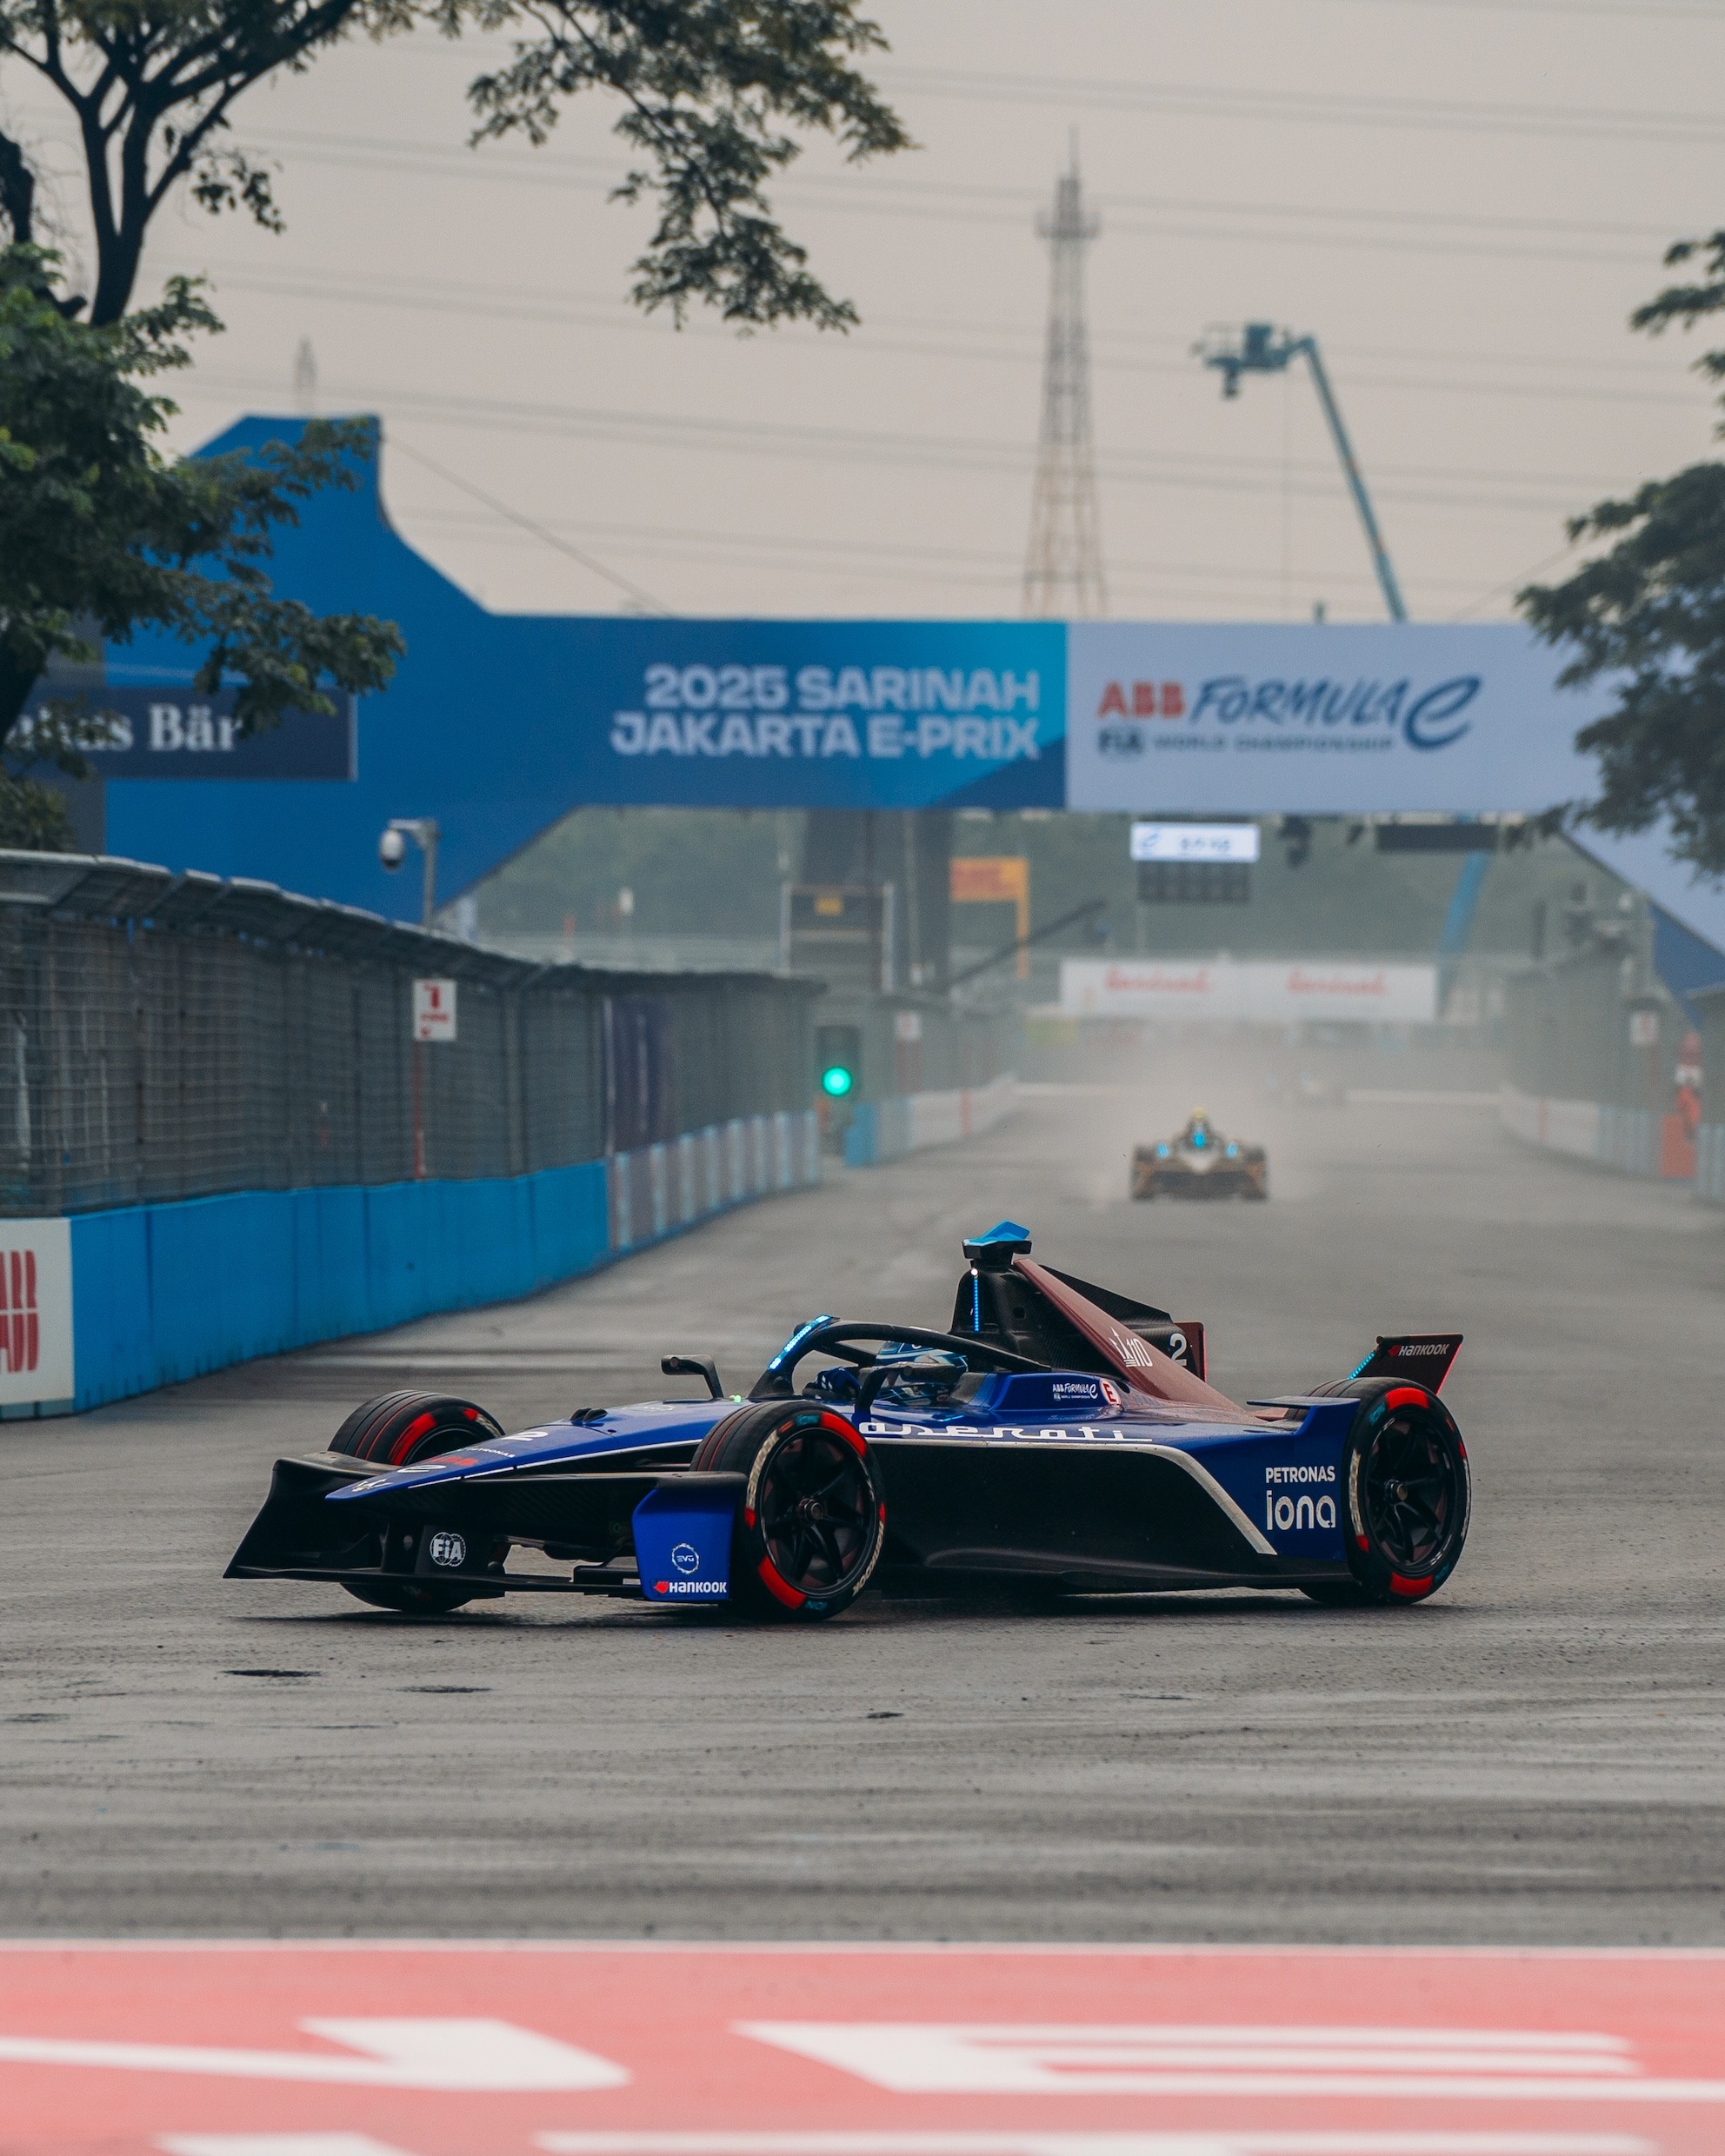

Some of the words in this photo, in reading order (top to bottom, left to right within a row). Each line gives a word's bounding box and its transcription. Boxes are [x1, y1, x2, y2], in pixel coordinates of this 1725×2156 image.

[644, 664, 789, 709] 2025
[796, 666, 1040, 712] SARINAH
[1097, 682, 1185, 719] ABB
[1189, 675, 1409, 725] FORMULA
[149, 702, 244, 751] Bär
[610, 711, 861, 756] JAKARTA
[868, 715, 1041, 760] E-PRIX
[1169, 1334, 1187, 1367] 2
[1102, 1383, 1118, 1403] E
[858, 1421, 1126, 1441] aserati
[1265, 1465, 1336, 1484] PETRONAS
[1266, 1489, 1336, 1531] iona
